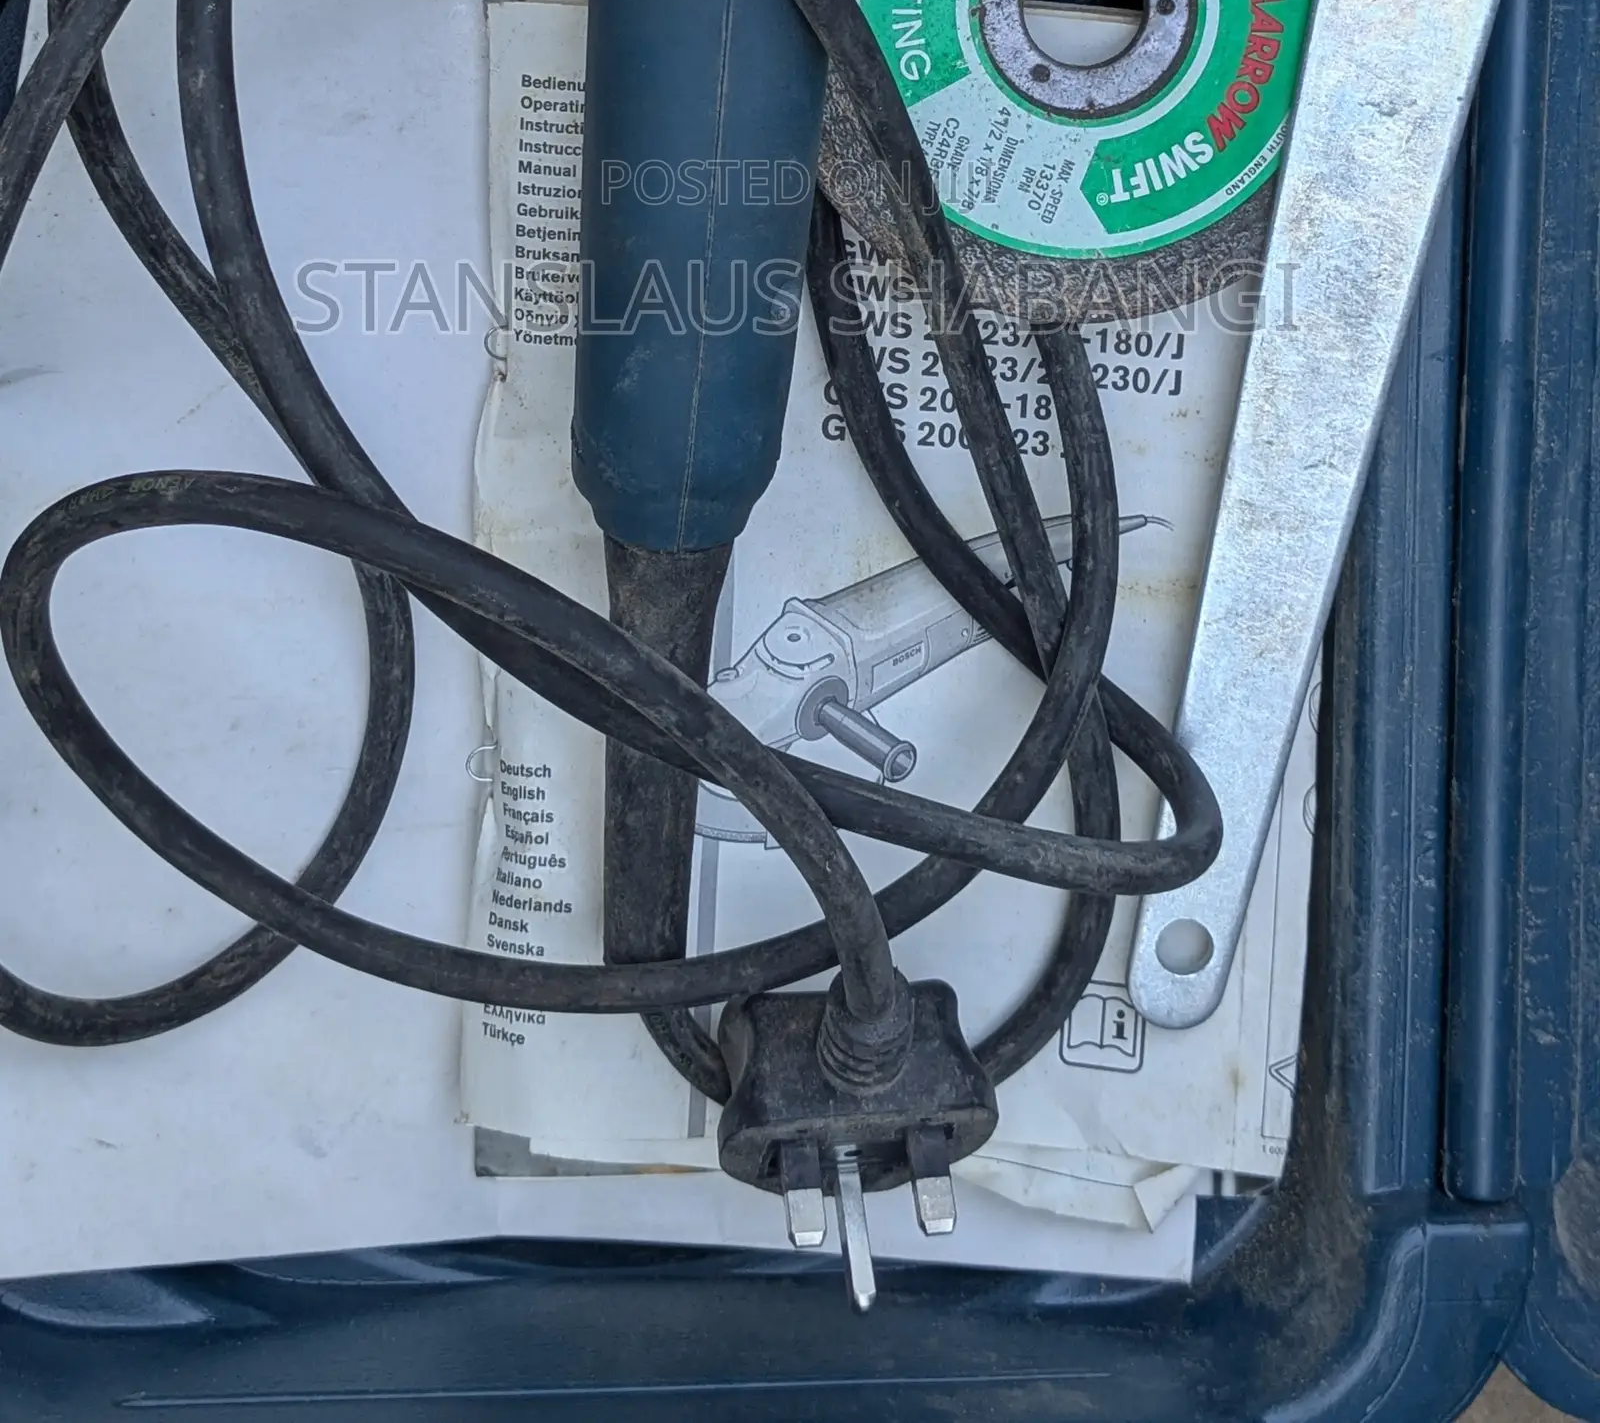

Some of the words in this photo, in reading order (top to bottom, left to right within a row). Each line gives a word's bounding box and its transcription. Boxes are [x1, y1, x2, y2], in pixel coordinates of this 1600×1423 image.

[921, 119, 942, 147] TYPE
[518, 160, 577, 178] Manual
[1110, 130, 1215, 204] SWIFT
[1225, 154, 1267, 196] ENGLAND
[1016, 166, 1037, 194] RPM
[1028, 163, 1057, 212] 13370
[1040, 188, 1064, 225] SPEED
[857, 275, 915, 303] WS
[864, 311, 913, 339] WS
[892, 645, 922, 667] BOSCH
[500, 759, 552, 779] Deutsch
[501, 781, 546, 801] English
[503, 802, 554, 825] Français
[505, 824, 549, 845] Español
[501, 846, 567, 869] Português
[496, 867, 543, 889] Italiano
[492, 889, 573, 914] Nederlands
[488, 911, 530, 933] Dansk
[486, 933, 545, 957] Svenska
[482, 1021, 526, 1046] Türkçe
